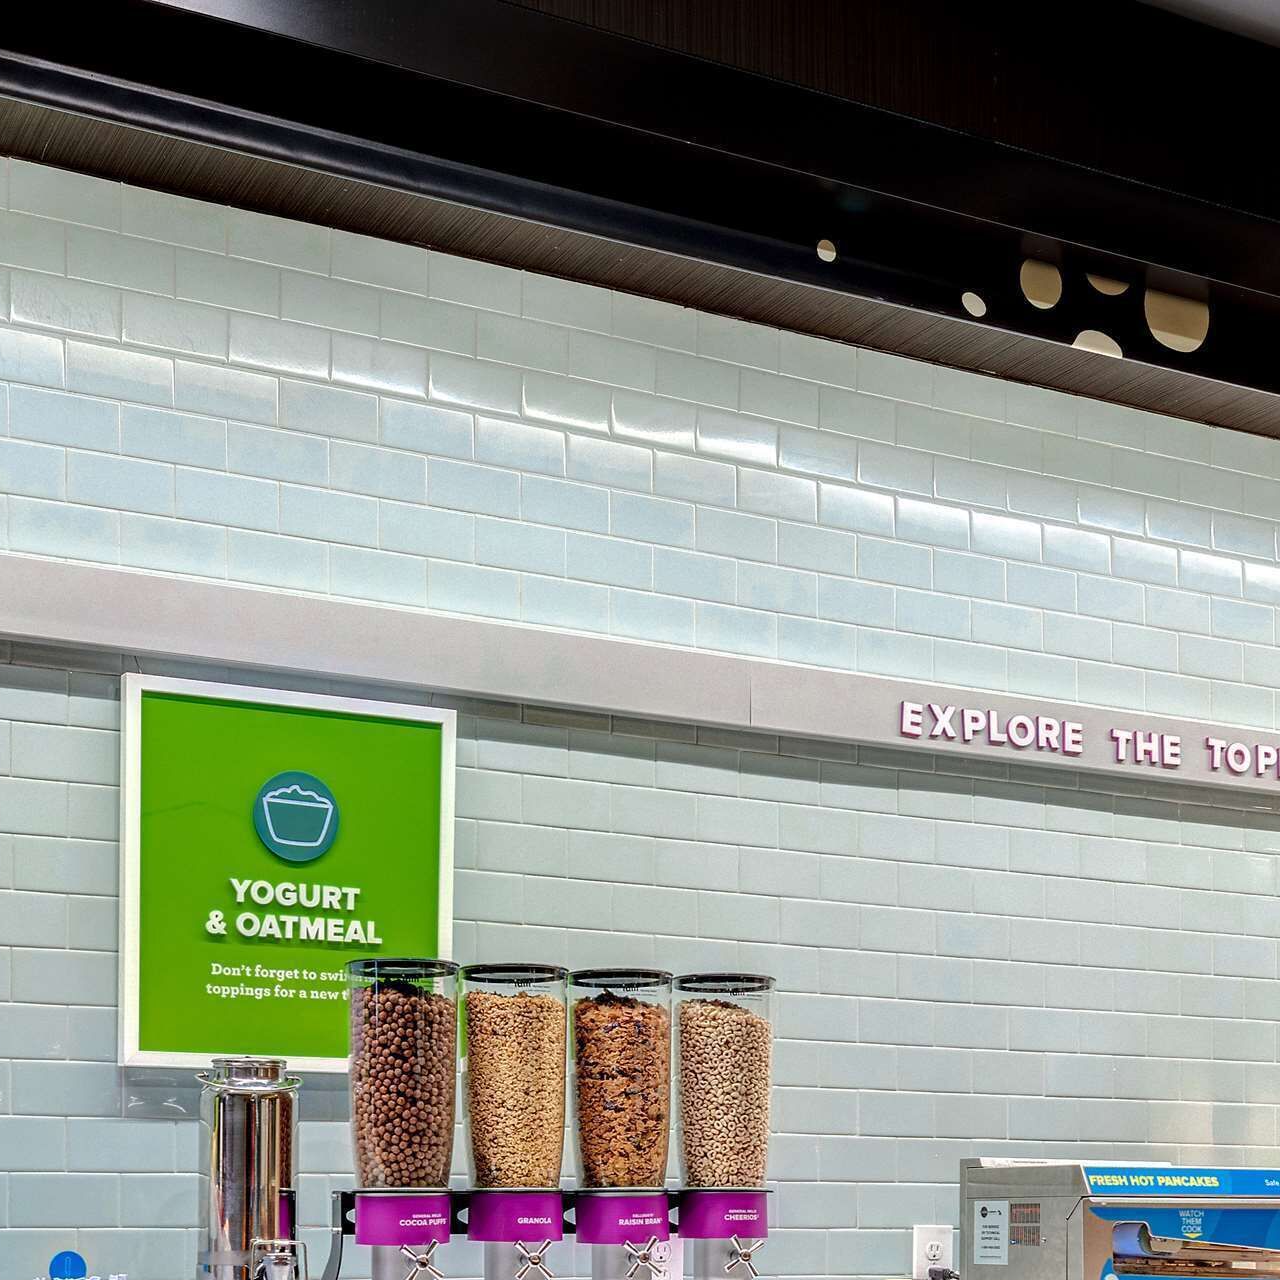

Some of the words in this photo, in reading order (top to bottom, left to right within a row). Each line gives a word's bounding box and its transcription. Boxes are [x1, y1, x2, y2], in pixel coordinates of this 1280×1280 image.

[899, 699, 1085, 756] EXPLORE
[1109, 727, 1183, 767] THE
[229, 878, 361, 911] YOGURT
[205, 909, 228, 935] &
[235, 912, 383, 945] OATMEAL
[211, 963, 252, 977] Don't
[254, 964, 300, 981] forget
[302, 968, 317, 980] to
[206, 982, 271, 1000] toppings
[274, 985, 296, 998] for
[299, 989, 308, 999] a
[310, 990, 339, 1000] new
[1087, 1174, 1127, 1186] FRESH
[1129, 1175, 1156, 1187] HOT
[1158, 1176, 1220, 1188] PANCAKES
[1264, 1178, 1280, 1186] Safe
[1179, 1209, 1205, 1218] WATCH
[517, 1217, 552, 1225] GRANOLA
[618, 1218, 644, 1226] RAISIN
[1182, 1217, 1202, 1225] THEM
[1181, 1225, 1202, 1233] COOK
